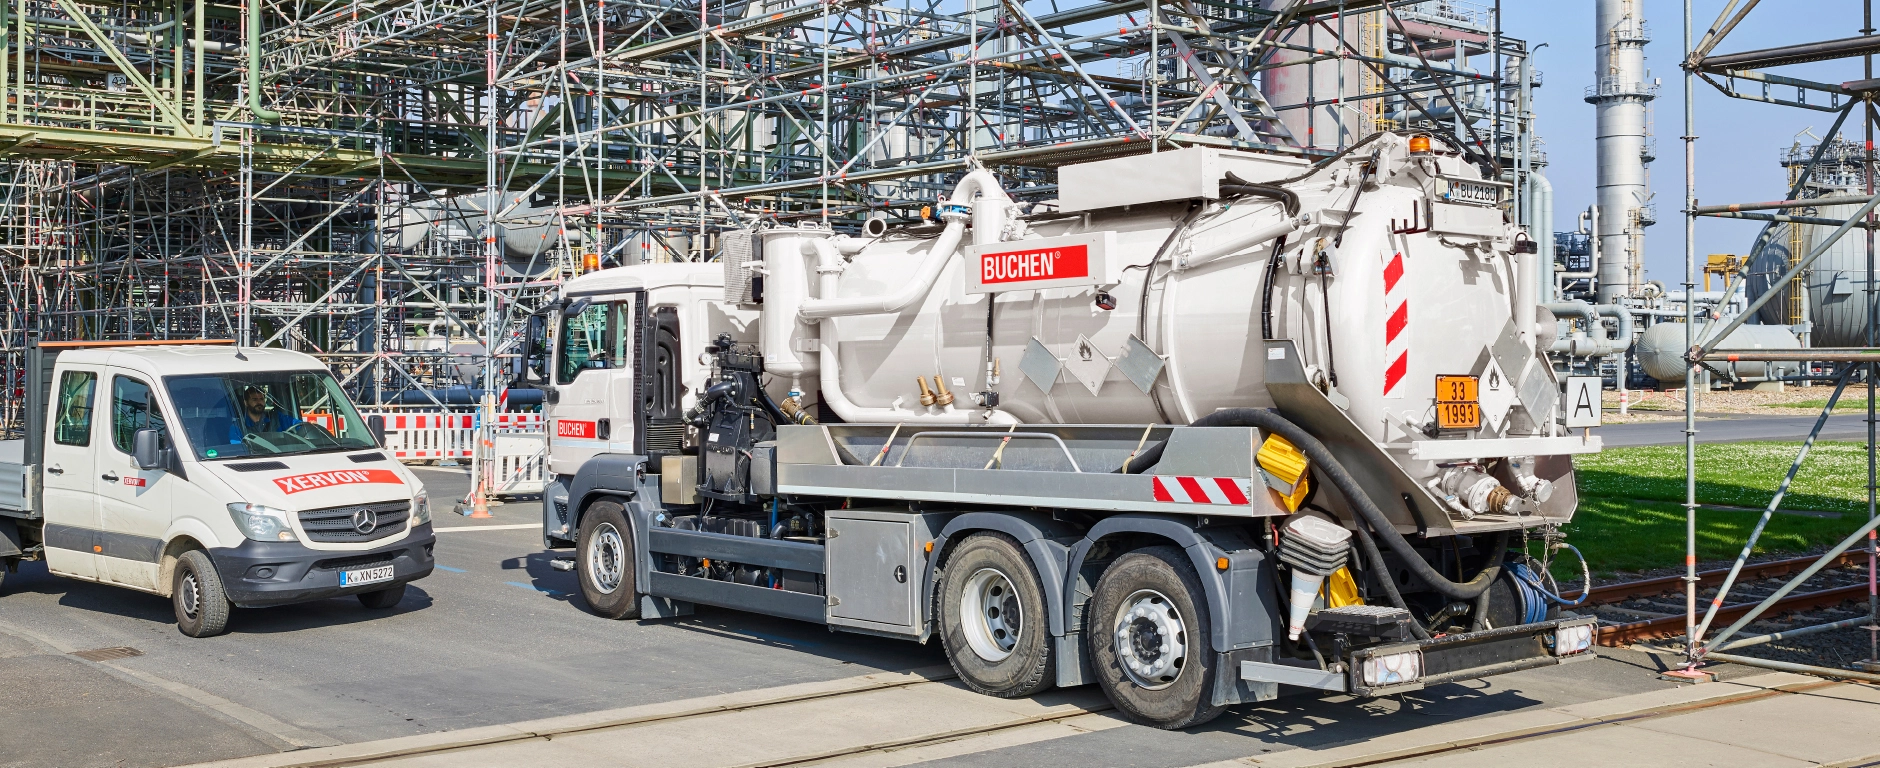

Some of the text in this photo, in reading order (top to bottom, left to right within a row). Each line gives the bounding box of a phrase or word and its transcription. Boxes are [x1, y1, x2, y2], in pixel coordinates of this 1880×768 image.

[1449, 182, 1455, 197] K
[1451, 381, 1465, 400] 33
[1574, 382, 1594, 418] A
[1445, 404, 1474, 424] 1993
[347, 572, 354, 583] K
